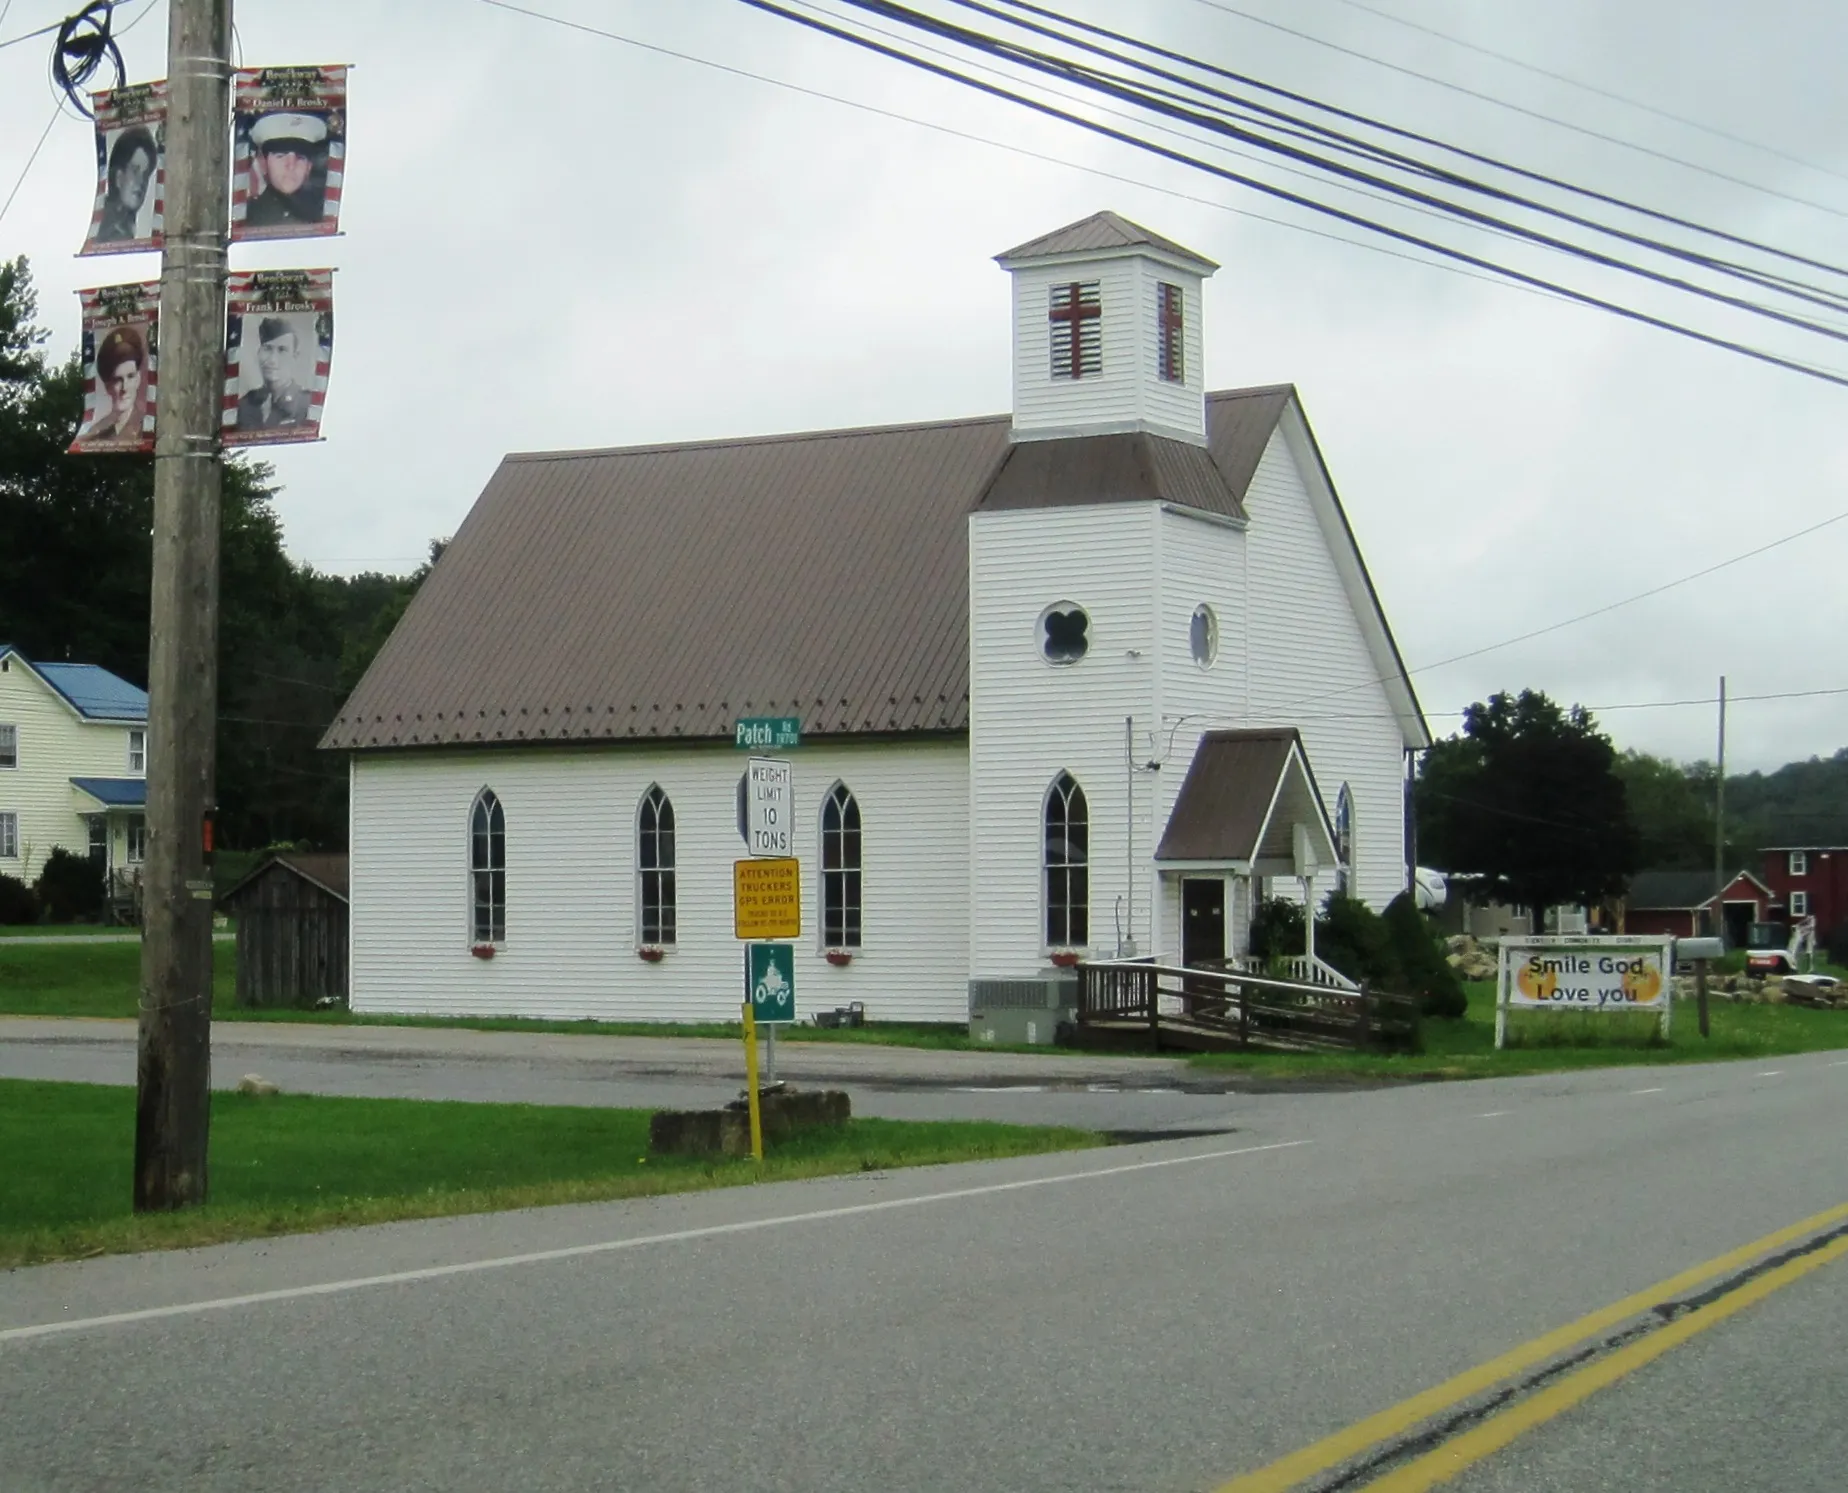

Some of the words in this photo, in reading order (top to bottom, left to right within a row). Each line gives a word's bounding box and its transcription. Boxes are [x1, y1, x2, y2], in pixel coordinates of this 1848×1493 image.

[253, 98, 284, 107] Daniel
[246, 302, 273, 312] Frank
[737, 723, 772, 744] Patch
[753, 768, 788, 782] WEIGHT
[758, 786, 782, 800] LIMIT
[764, 808, 777, 825] 10
[755, 830, 786, 849] TONS
[740, 867, 793, 878] ATTENTION
[741, 881, 792, 892] TRUCKERS
[739, 896, 758, 906] GPS
[762, 895, 794, 905] ERROR
[1529, 956, 1590, 974] Smile
[1599, 956, 1643, 974] God
[1537, 984, 1590, 1001] Love
[1598, 988, 1638, 1006] you
